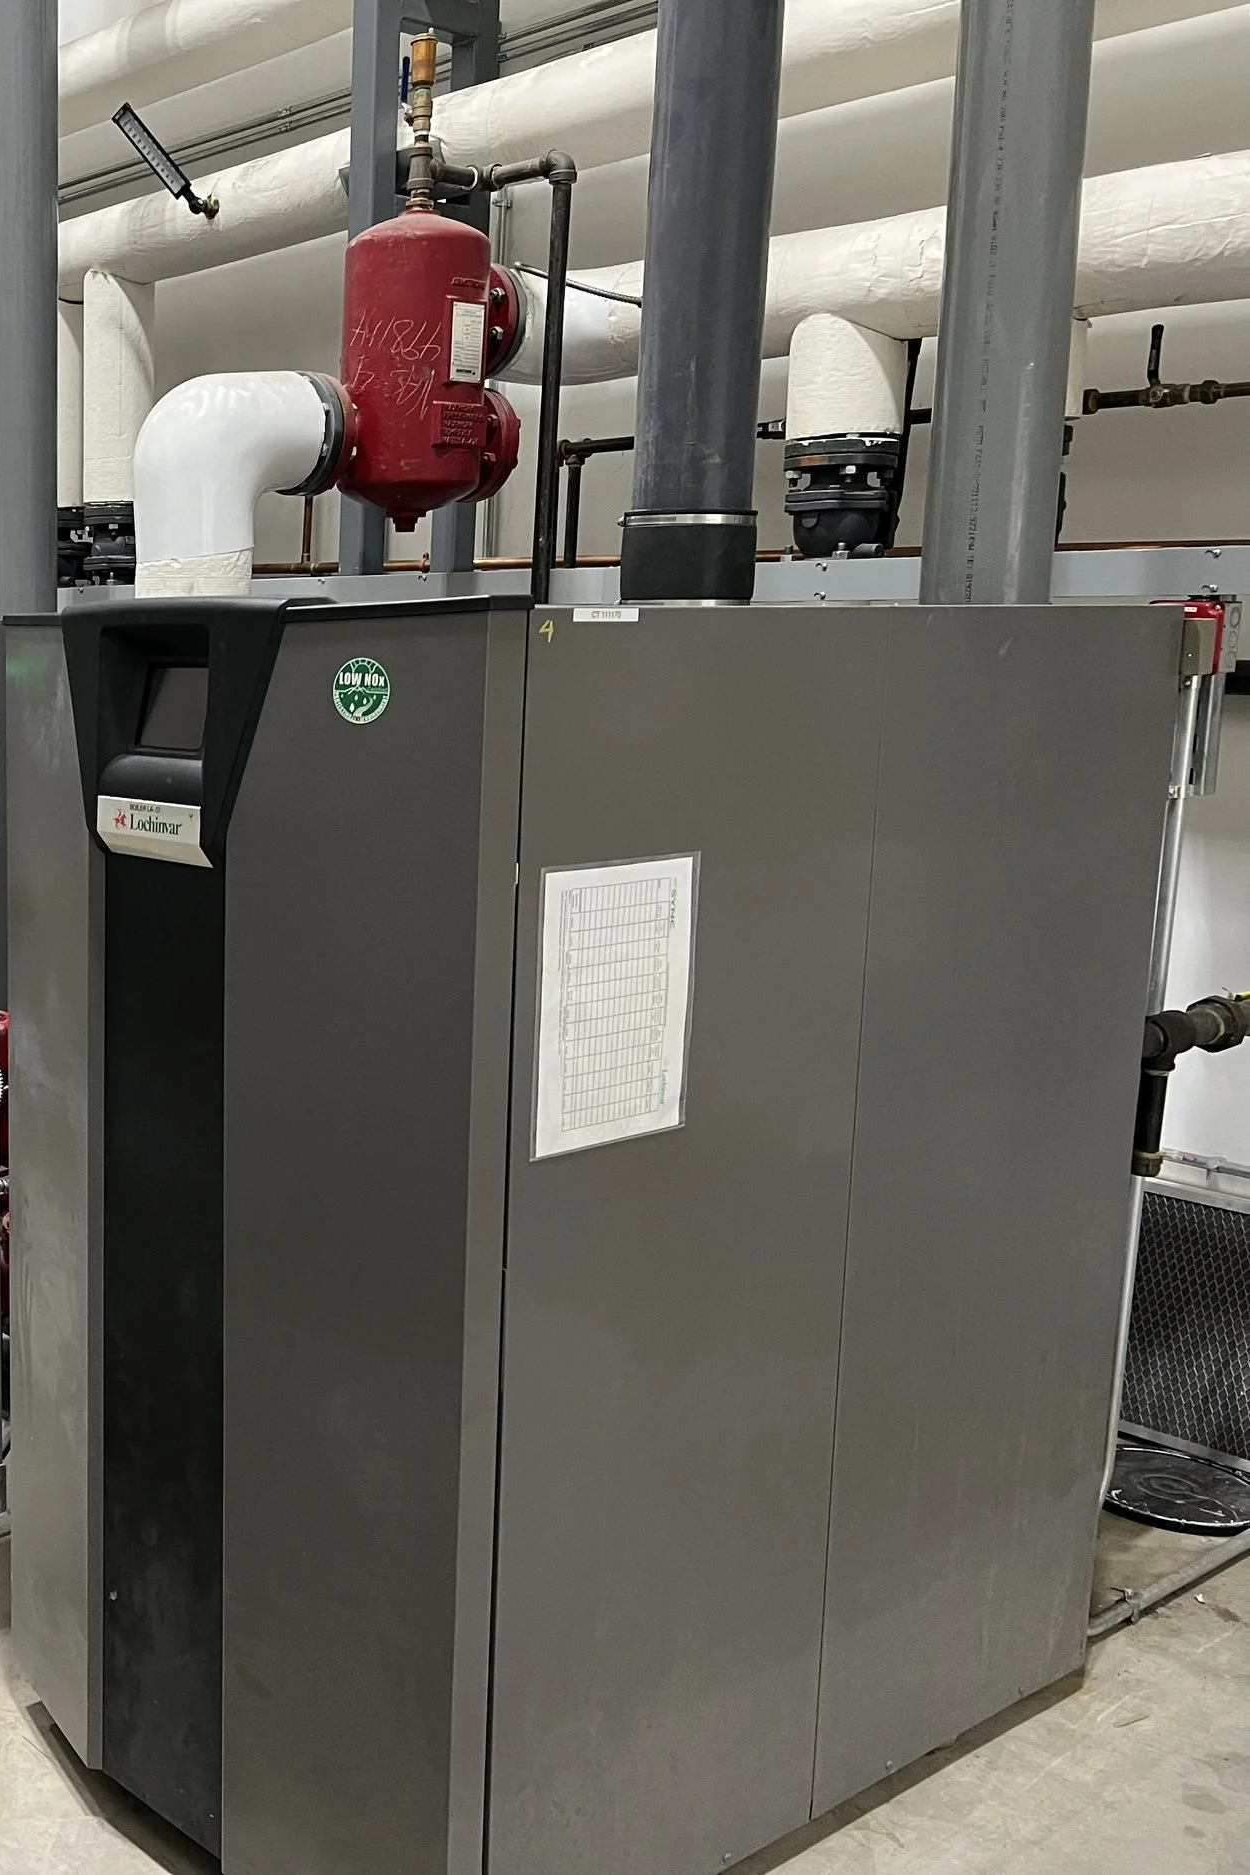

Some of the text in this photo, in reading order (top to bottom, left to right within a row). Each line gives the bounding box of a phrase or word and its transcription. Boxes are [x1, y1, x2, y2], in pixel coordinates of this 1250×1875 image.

[591, 610, 601, 619] CT
[538, 619, 555, 644] 4
[338, 671, 363, 686] LOW
[129, 813, 183, 835] Lochinvar
[669, 889, 678, 930] SYNC
